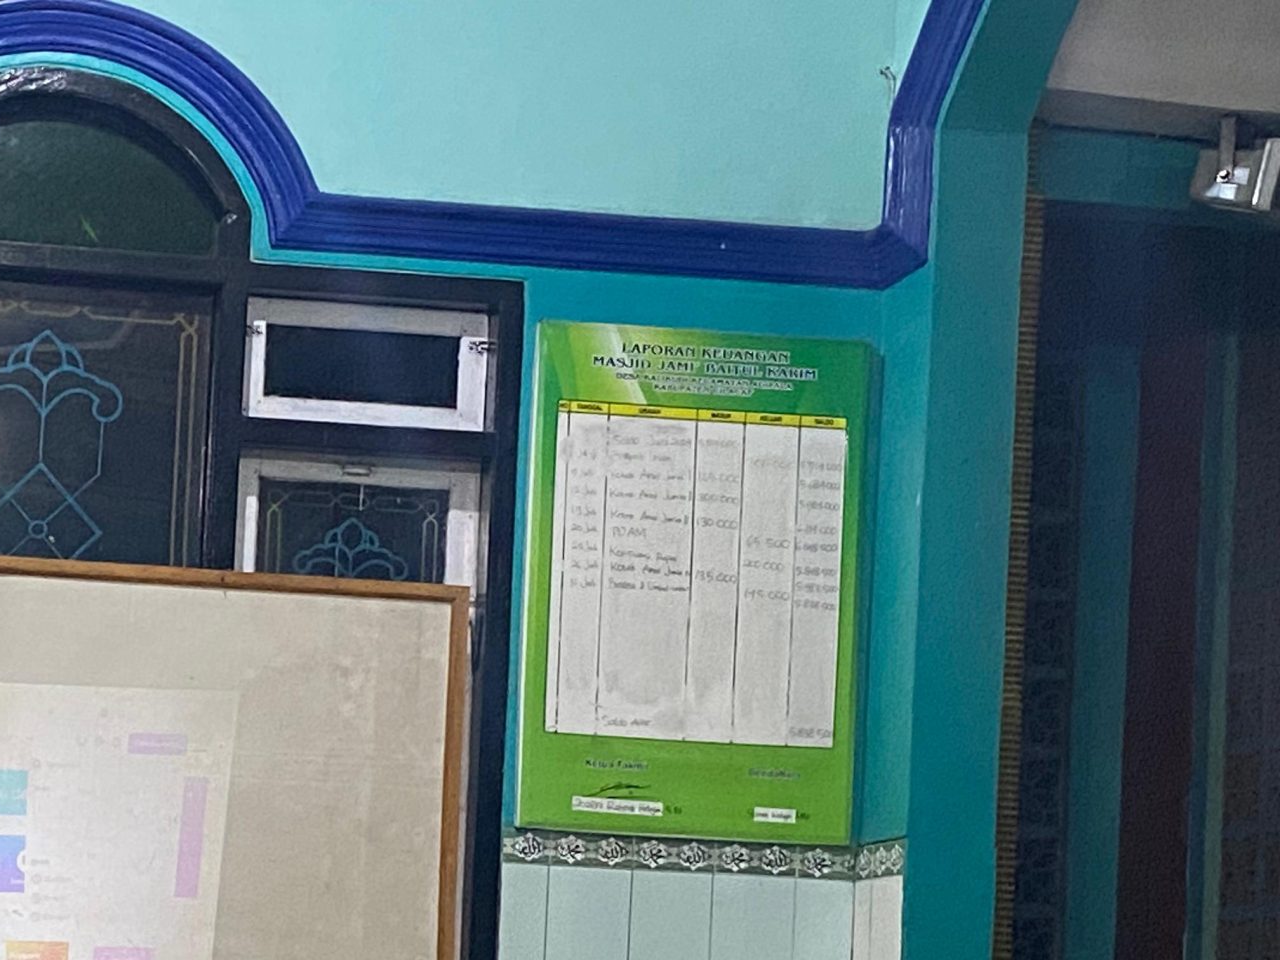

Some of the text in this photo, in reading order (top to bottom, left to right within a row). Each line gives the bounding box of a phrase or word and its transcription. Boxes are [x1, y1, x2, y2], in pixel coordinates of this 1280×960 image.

[621, 342, 789, 363] LAPORAN KEUANGAN
[592, 356, 652, 369] MASJID
[705, 363, 762, 377] BAITUL
[767, 366, 816, 380] KARIM
